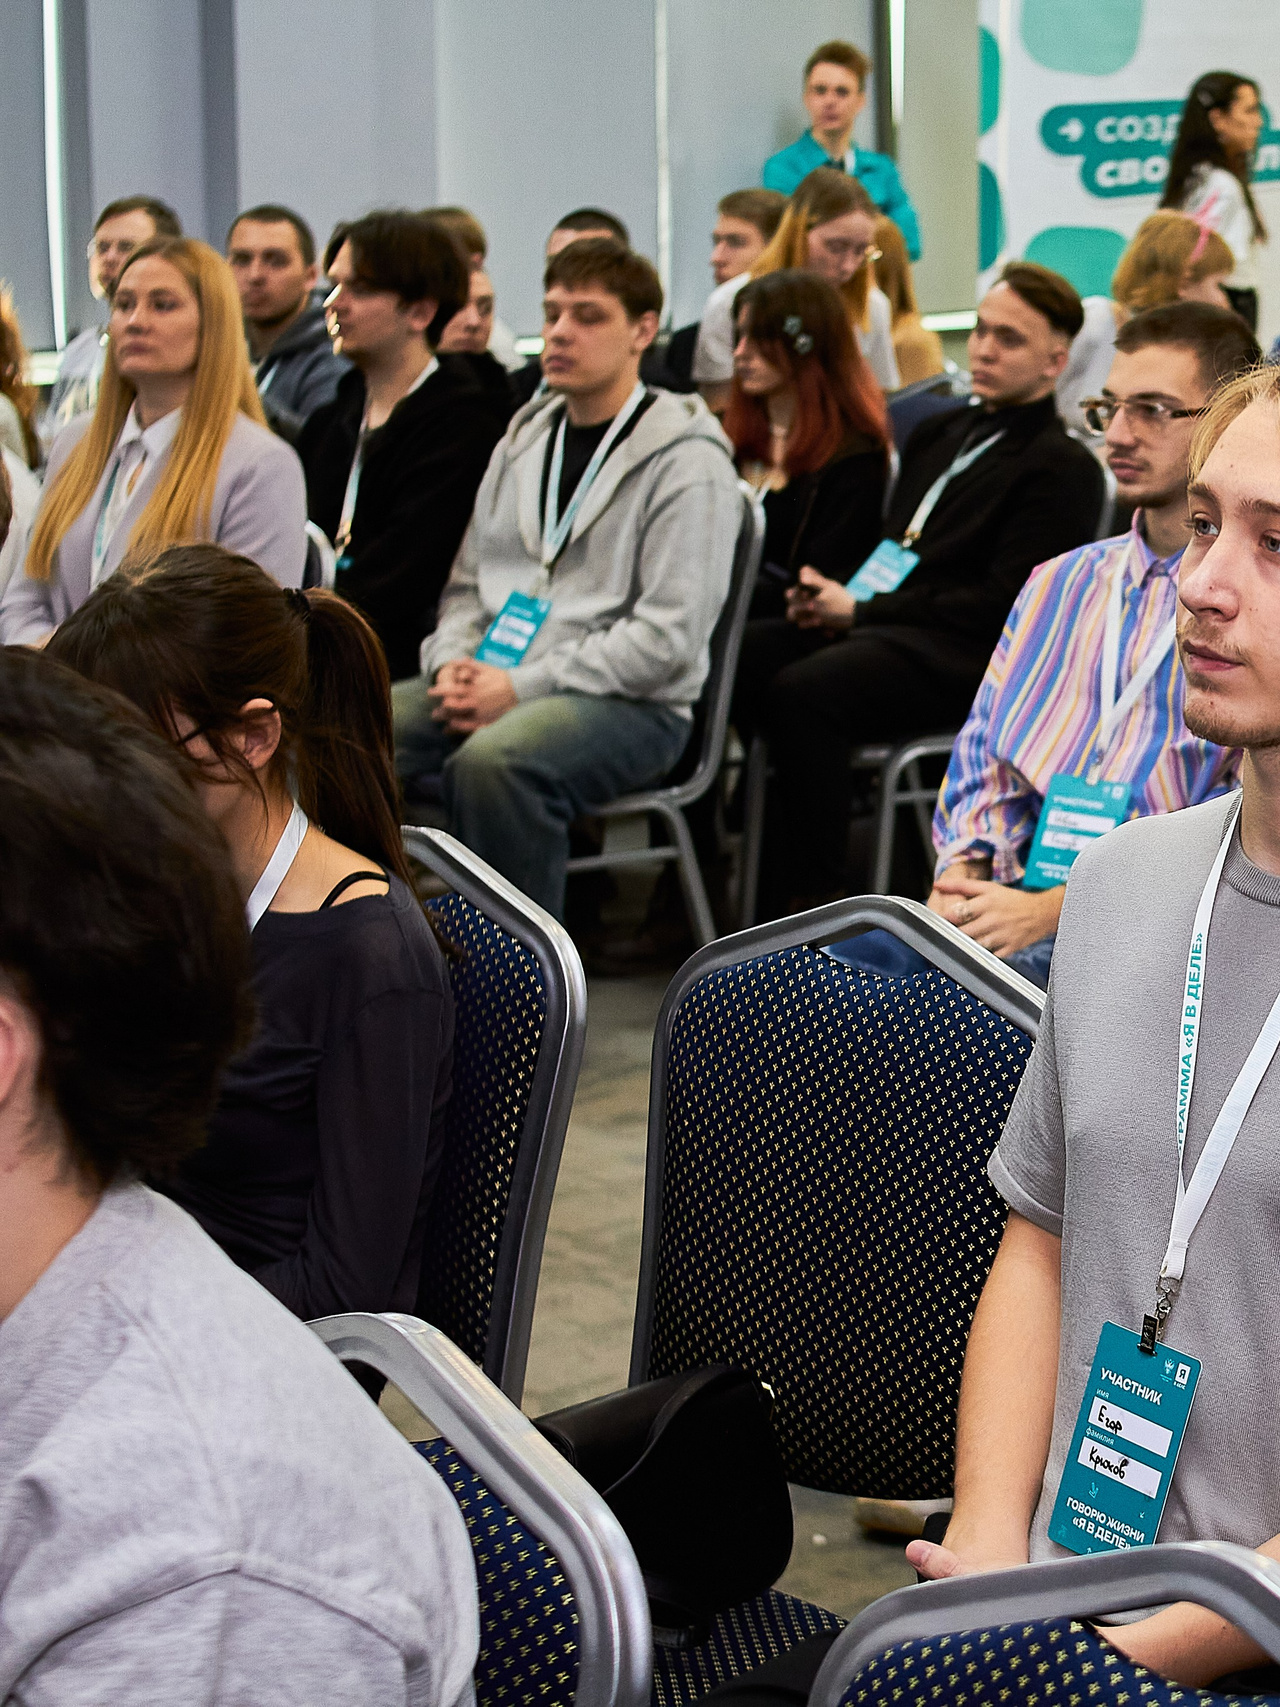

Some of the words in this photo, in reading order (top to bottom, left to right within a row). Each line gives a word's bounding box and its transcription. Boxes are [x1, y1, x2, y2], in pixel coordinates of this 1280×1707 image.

[1187, 932, 1203, 1001] ДЕЛЕ»
[1185, 1004, 1197, 1018] В
[1183, 1023, 1195, 1048] «Я
[1178, 1053, 1193, 1150] ГРАММА
[1101, 1367, 1163, 1406] УЧАСТНИК
[1098, 1404, 1123, 1434] Егор
[1085, 1426, 1115, 1446] фамилия
[1089, 1446, 1130, 1479] Крюков
[1066, 1497, 1107, 1524] ГОВОРЮ
[1106, 1516, 1145, 1543] ЖИЗНИ
[1072, 1516, 1087, 1531] «Я
[1086, 1522, 1096, 1535] В
